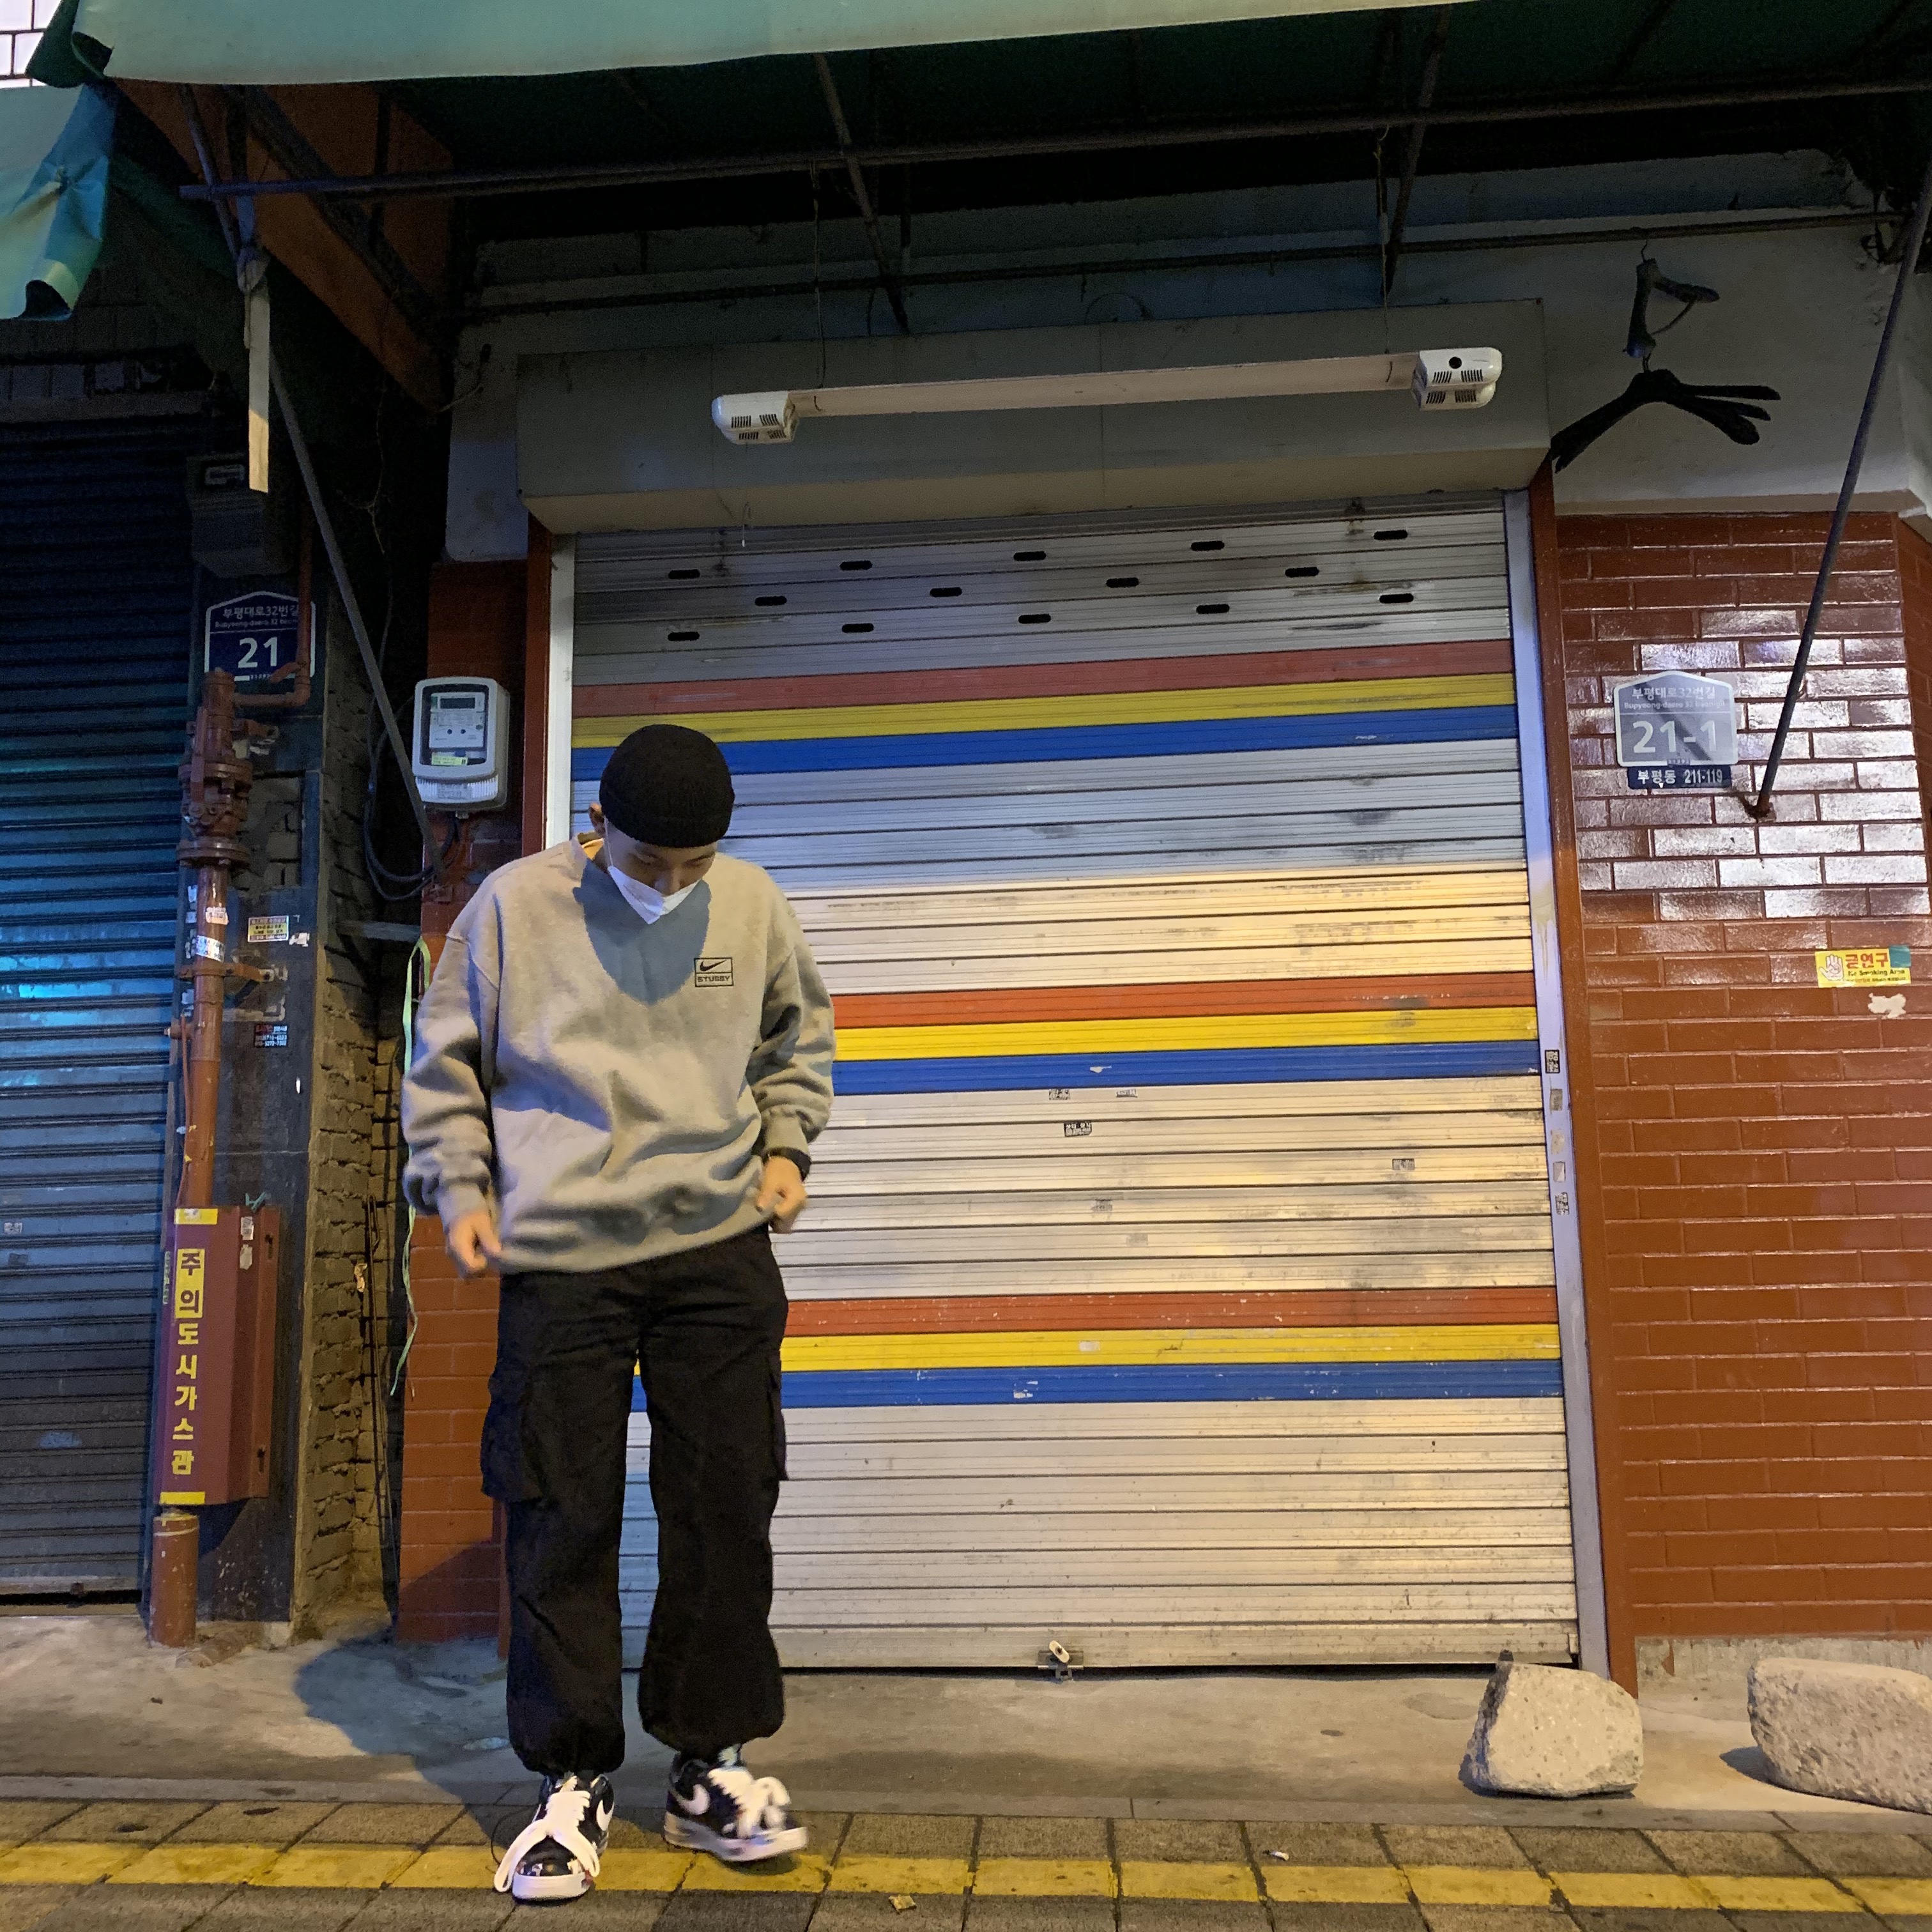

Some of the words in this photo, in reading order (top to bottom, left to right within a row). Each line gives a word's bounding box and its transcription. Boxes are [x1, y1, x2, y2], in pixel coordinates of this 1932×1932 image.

[238, 636, 277, 668] 21
[1625, 701, 1683, 710] Bupyeong-daero
[1632, 686, 1716, 702] 부평대로32번길
[1632, 719, 1717, 753] 21-1
[1637, 770, 1676, 785] 부평동
[1845, 952, 1889, 969] 금연구
[179, 1251, 203, 1314] 주의
[171, 1322, 199, 1476] 도시가스관
